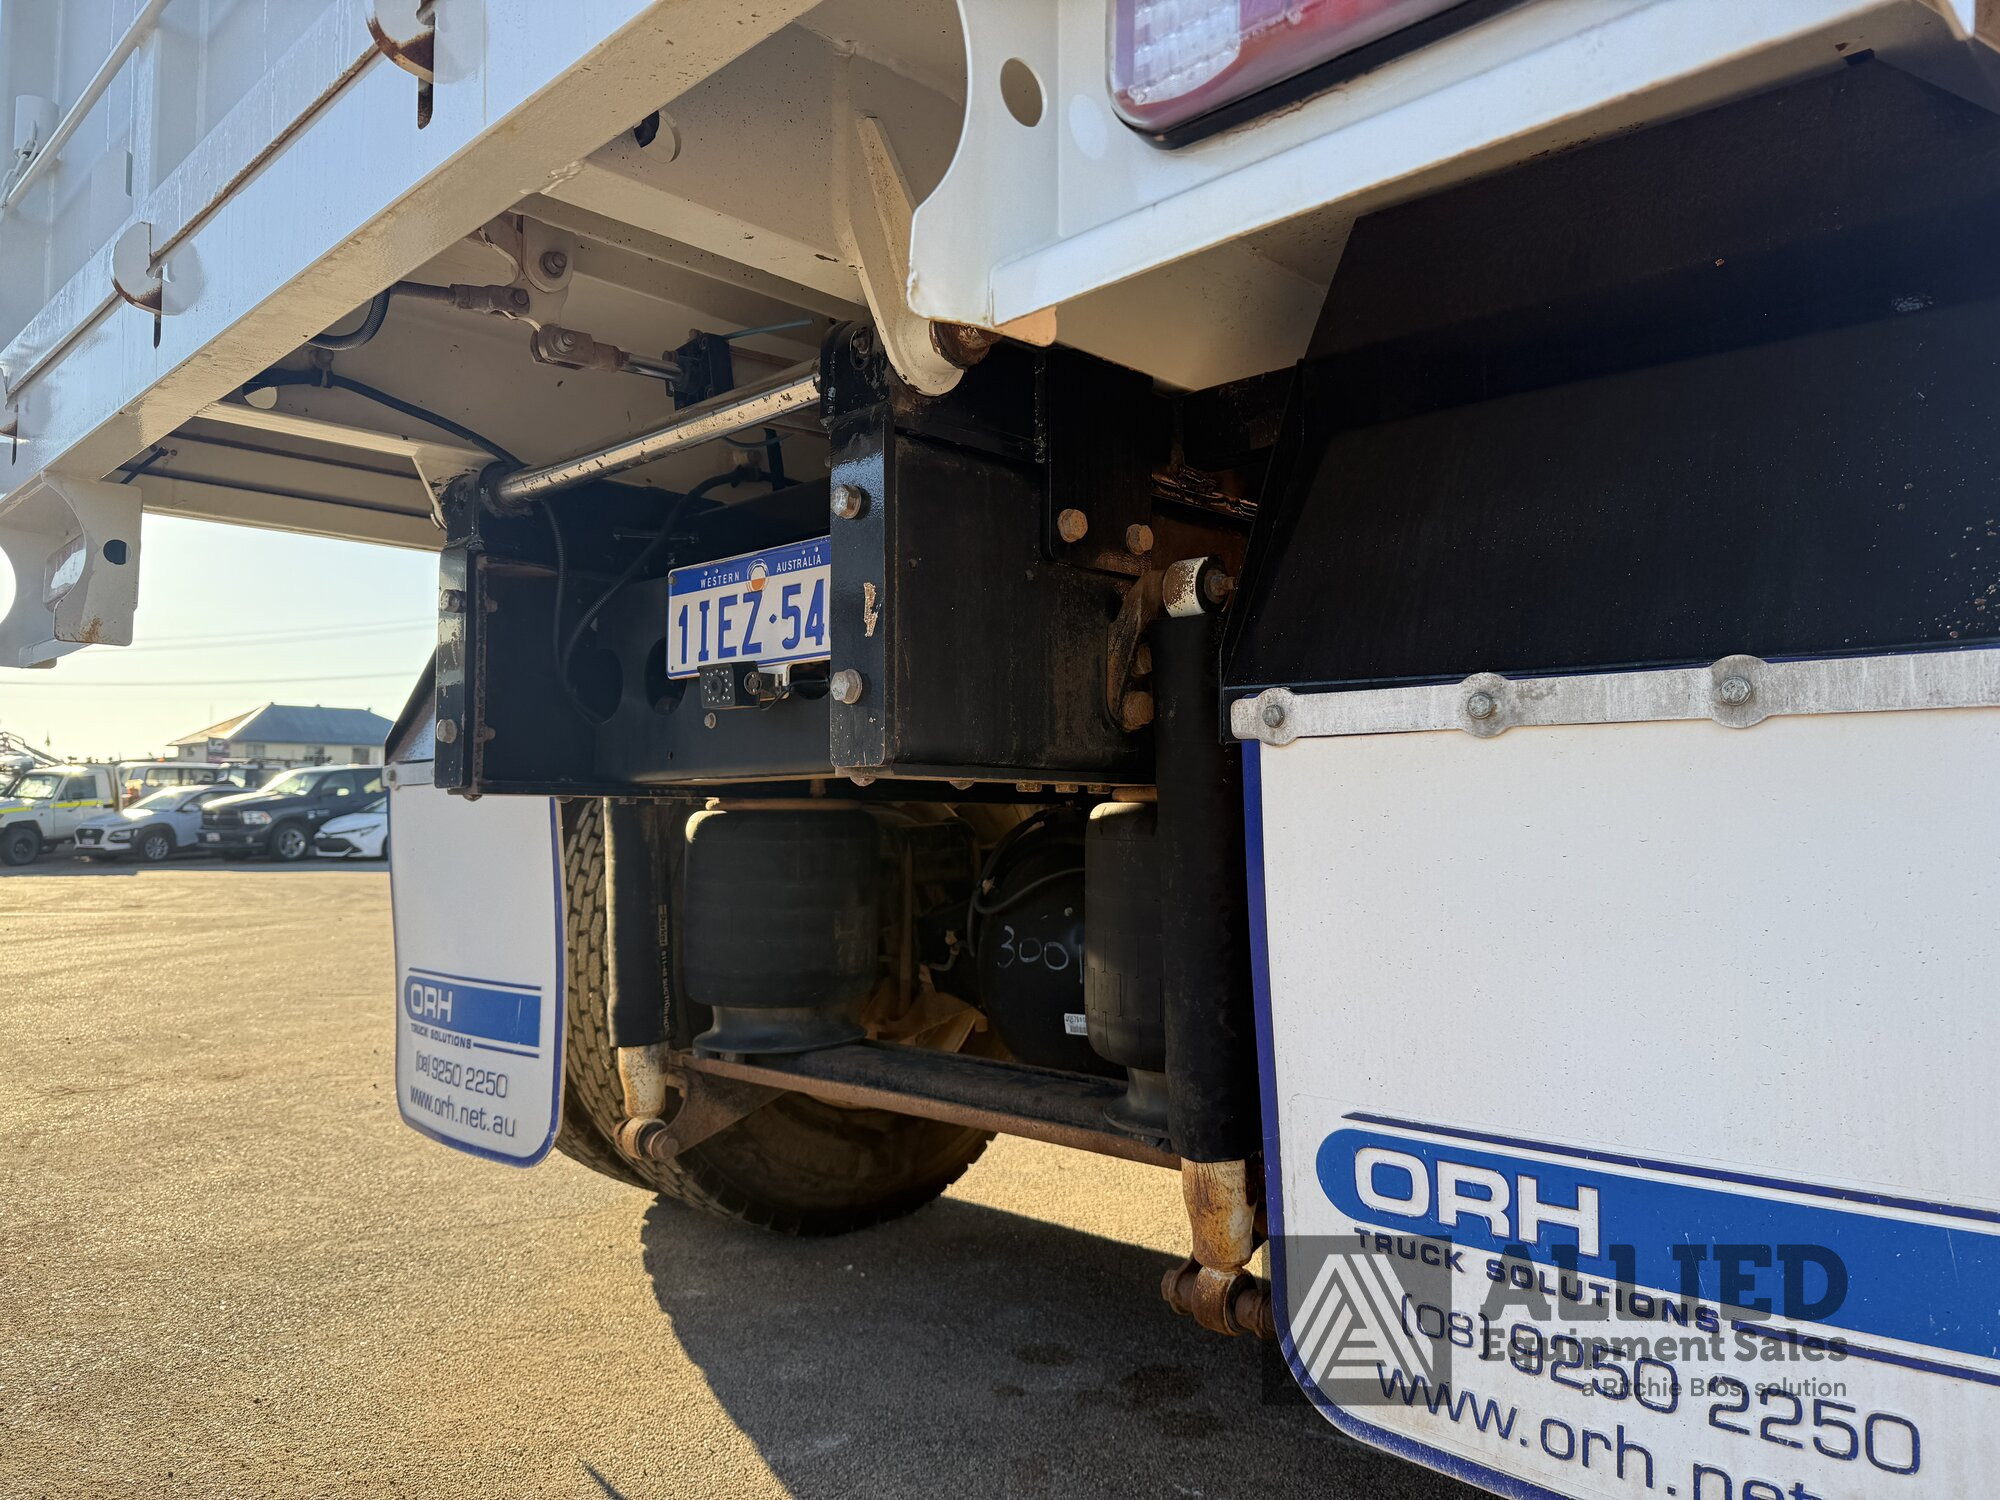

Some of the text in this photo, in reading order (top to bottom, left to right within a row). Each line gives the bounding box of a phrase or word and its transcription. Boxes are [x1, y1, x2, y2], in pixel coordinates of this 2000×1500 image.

[700, 554, 822, 588] WESTERN AUSTRALIA
[410, 982, 453, 1023] ORH
[410, 1023, 472, 1049] TRUCK SOLUTIONS
[415, 1050, 508, 1098] (08) 9250 2250
[410, 1085, 516, 1138] www.orh.net.au
[1354, 1146, 1600, 1258] ORH
[1353, 1226, 1721, 1334] TRUCK SOLUTIONS
[1401, 1292, 1921, 1476] (08) 9250 2250
